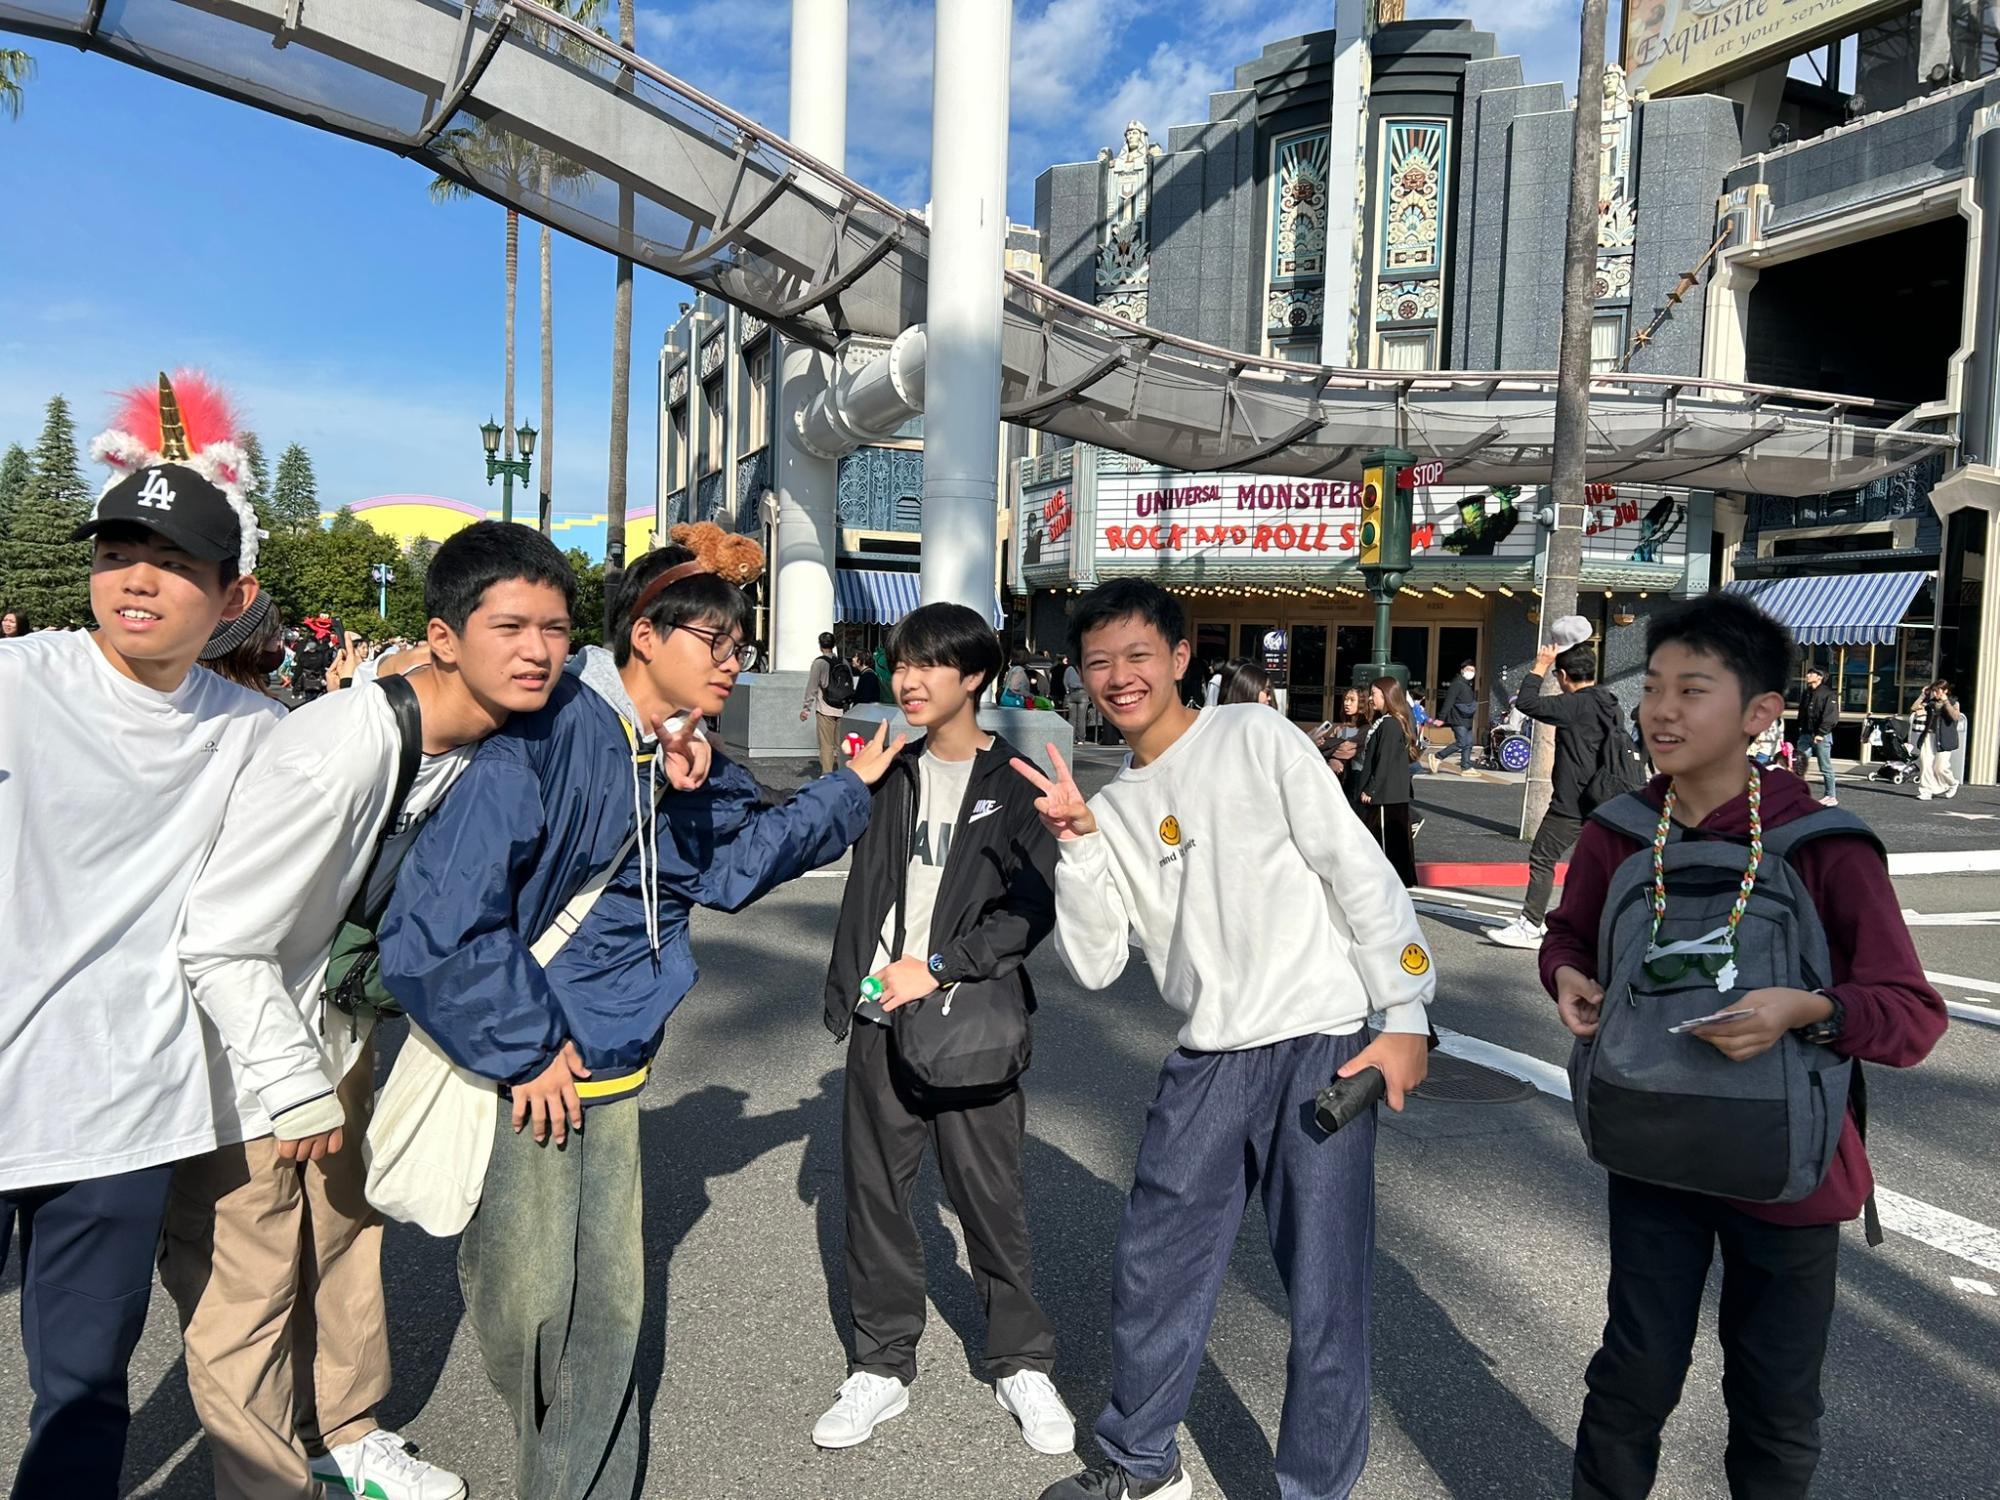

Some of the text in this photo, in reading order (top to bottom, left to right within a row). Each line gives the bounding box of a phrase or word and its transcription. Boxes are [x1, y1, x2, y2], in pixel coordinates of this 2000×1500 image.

[1635, 0, 1769, 68] Exquisite
[1714, 0, 1843, 57] at your servi
[137, 469, 176, 511] LA
[1413, 462, 1443, 486] STOP
[1136, 481, 1363, 517] UNIVERSAL MONSTER
[1105, 524, 1187, 550] ROCK
[1195, 524, 1246, 546] AND
[1253, 522, 1328, 551] ROLL
[972, 799, 997, 814] NIKE
